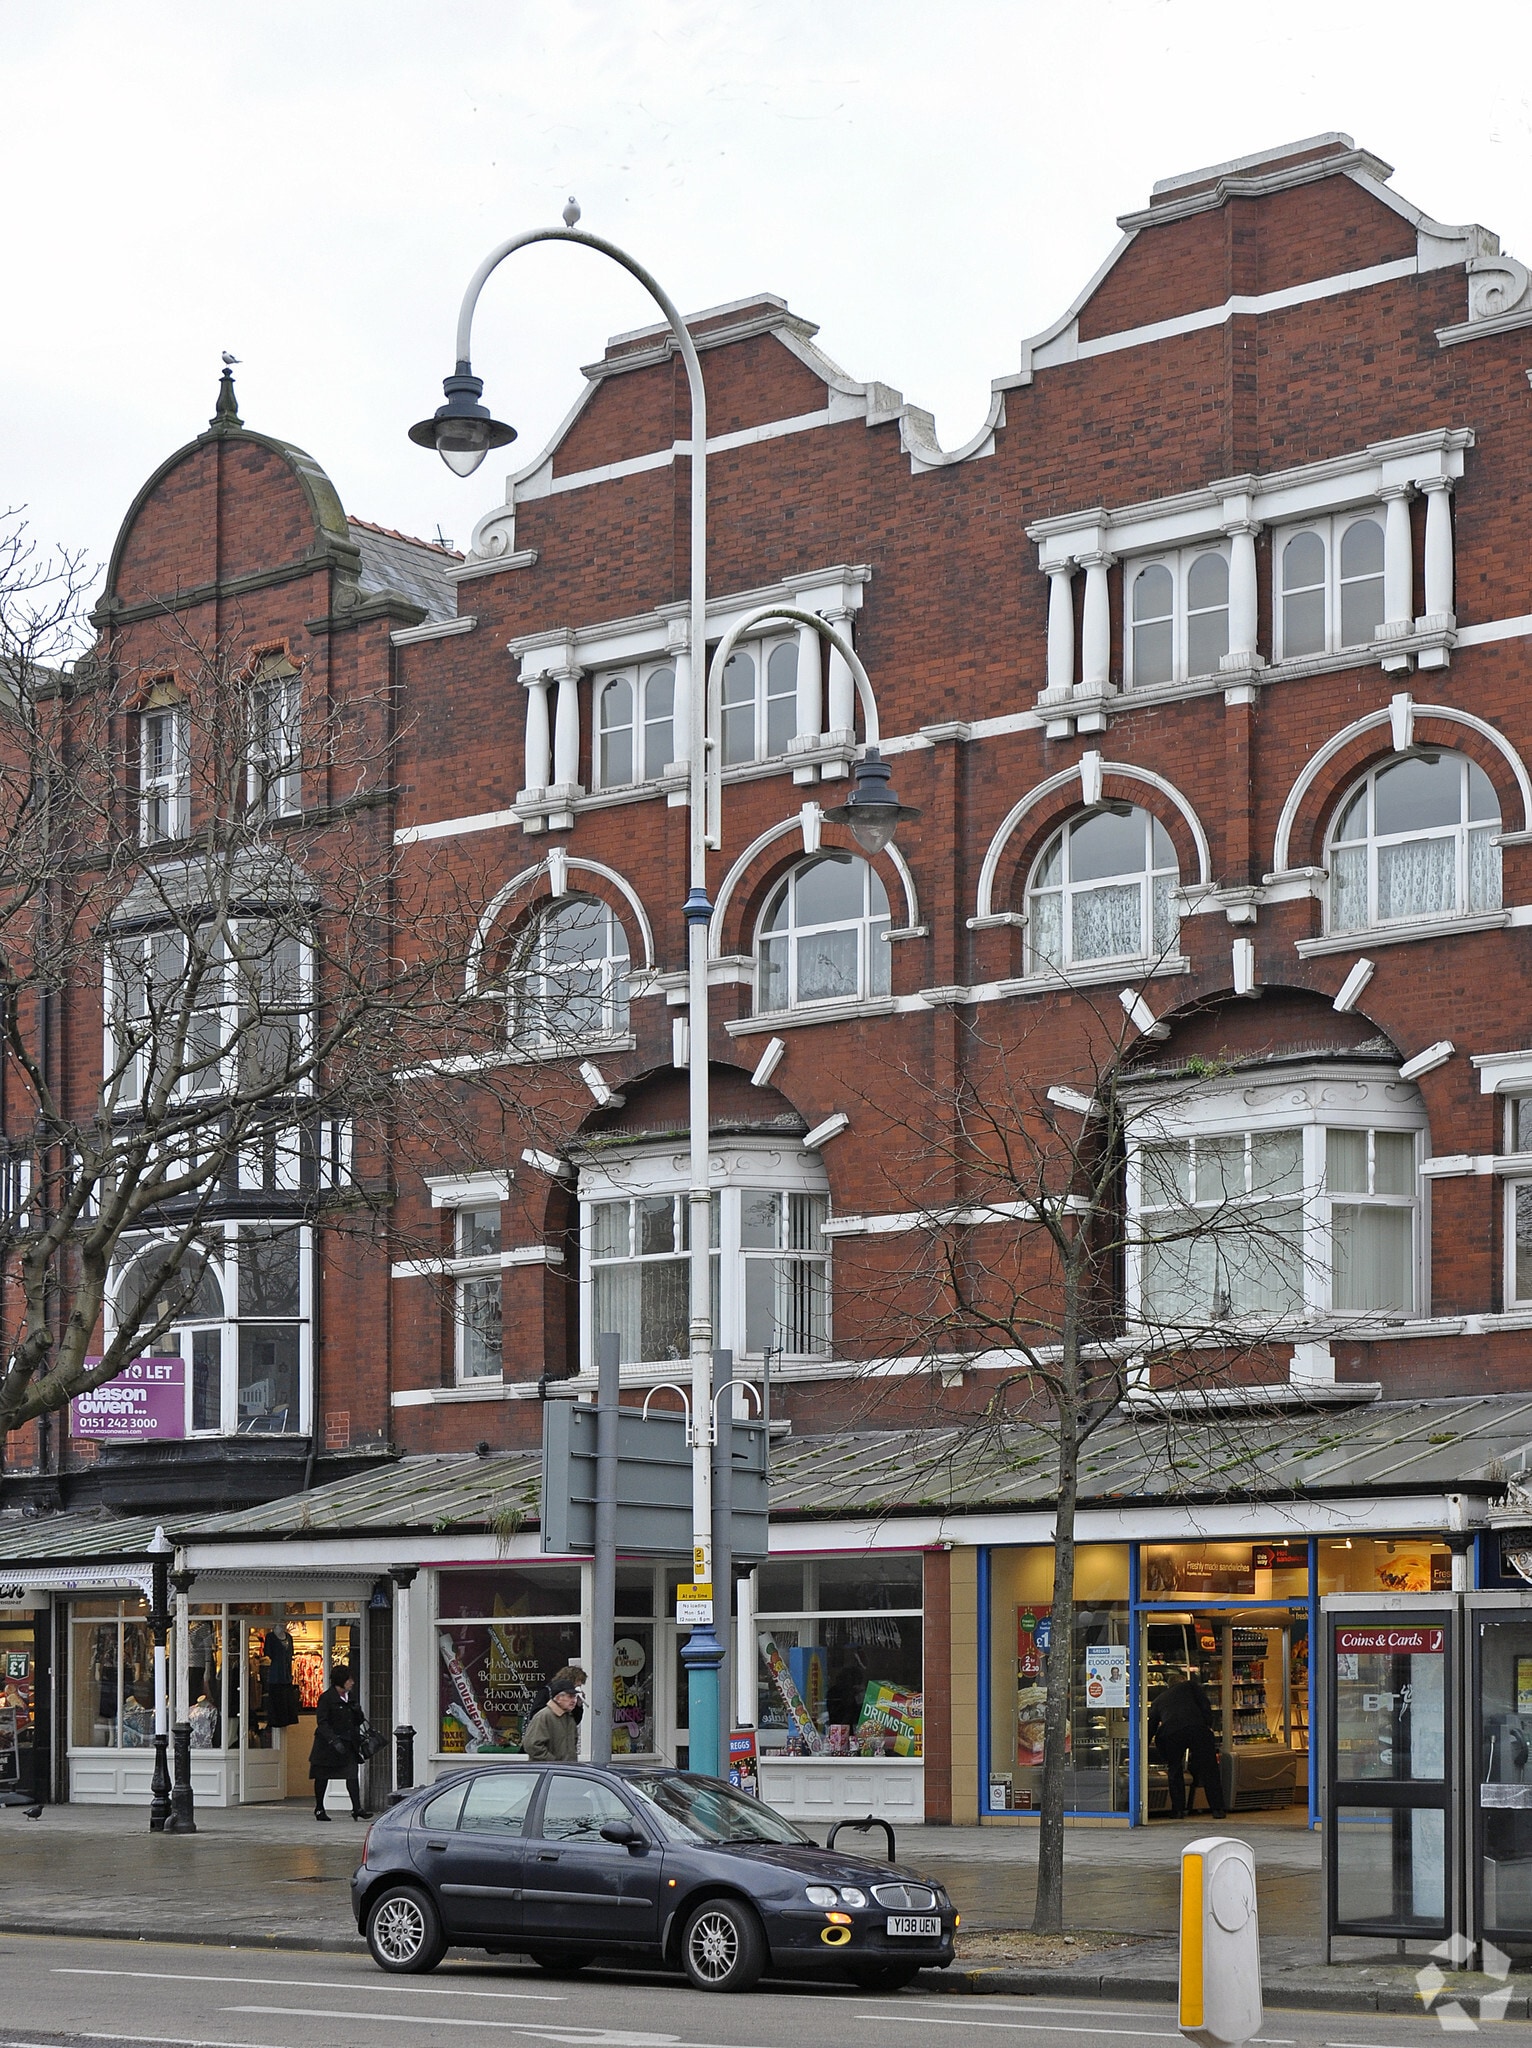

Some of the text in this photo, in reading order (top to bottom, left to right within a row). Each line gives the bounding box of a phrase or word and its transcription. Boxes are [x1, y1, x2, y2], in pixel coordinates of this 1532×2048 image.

[124, 1365, 172, 1379] TO LET
[78, 1388, 146, 1401] mason
[80, 1418, 158, 1428] 0151 242 3000
[696, 1550, 702, 1558] 2
[1186, 1561, 1250, 1572] Freshly made sandwiches
[1434, 1569, 1451, 1578] Fres
[1036, 1632, 1050, 1648] £1.
[1341, 1632, 1423, 1646] Coins & Cards
[9, 1661, 25, 1676] £1
[484, 1658, 539, 1669] HANDMADE
[478, 1670, 546, 1682] BOILED SWEETS
[484, 1700, 532, 1712] CHOCOLAT
[1363, 1693, 1400, 1712] BT
[864, 1704, 915, 1740] DRUMSTIC
[730, 1740, 750, 1751] REGGS
[894, 1918, 936, 1933] Y138 UEN
